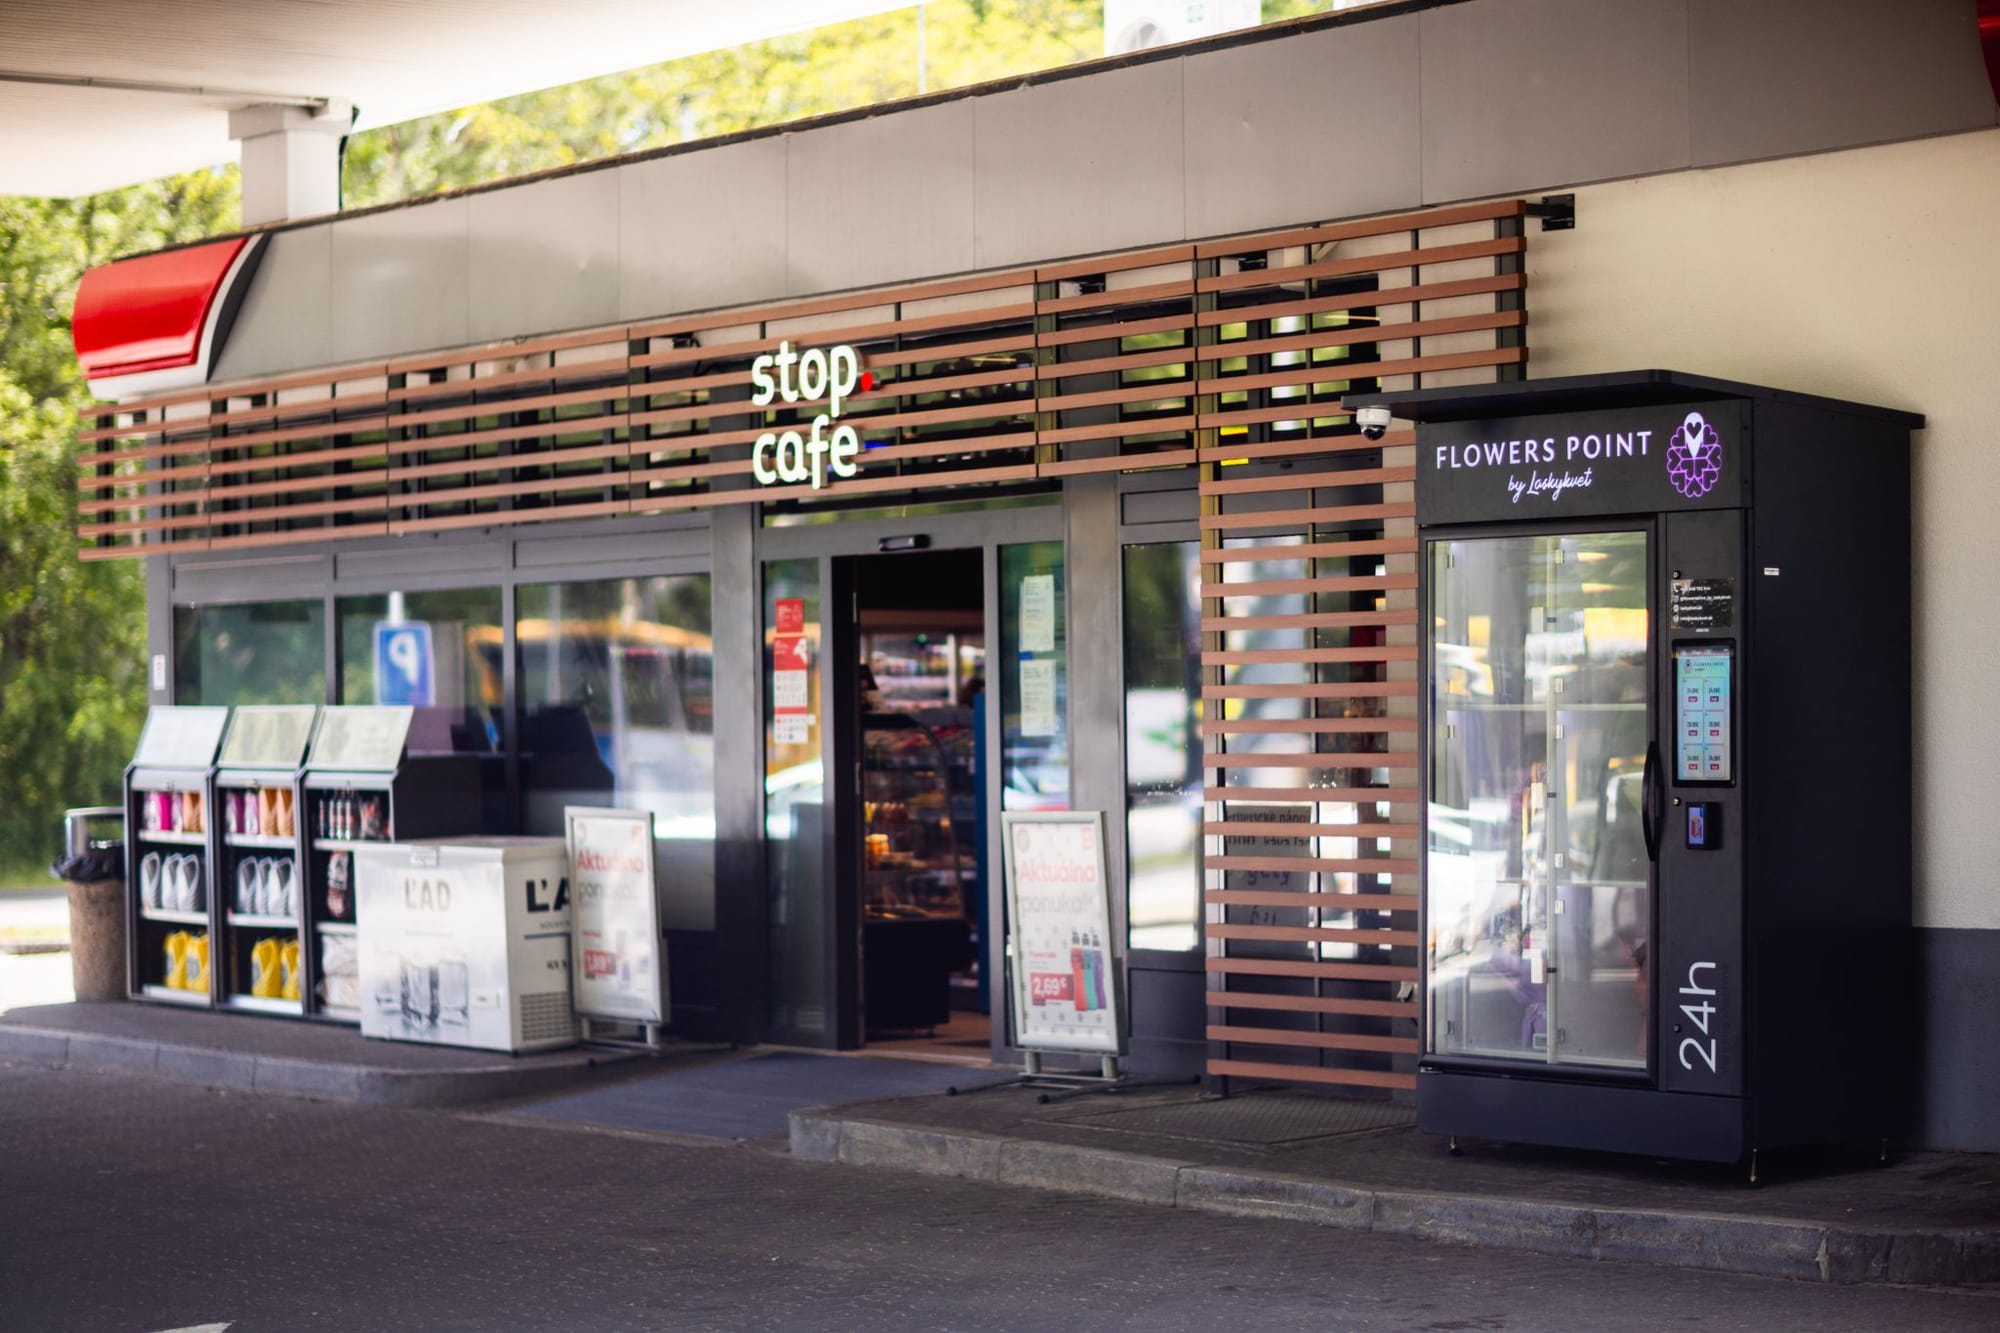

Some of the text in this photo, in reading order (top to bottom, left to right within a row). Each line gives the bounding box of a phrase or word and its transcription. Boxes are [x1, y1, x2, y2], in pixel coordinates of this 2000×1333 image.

[752, 414, 859, 490] cafe
[1436, 430, 1653, 470] FLOWERS POINT
[1507, 467, 1593, 504] by Laskykvet
[1679, 961, 1716, 1073] 24h
